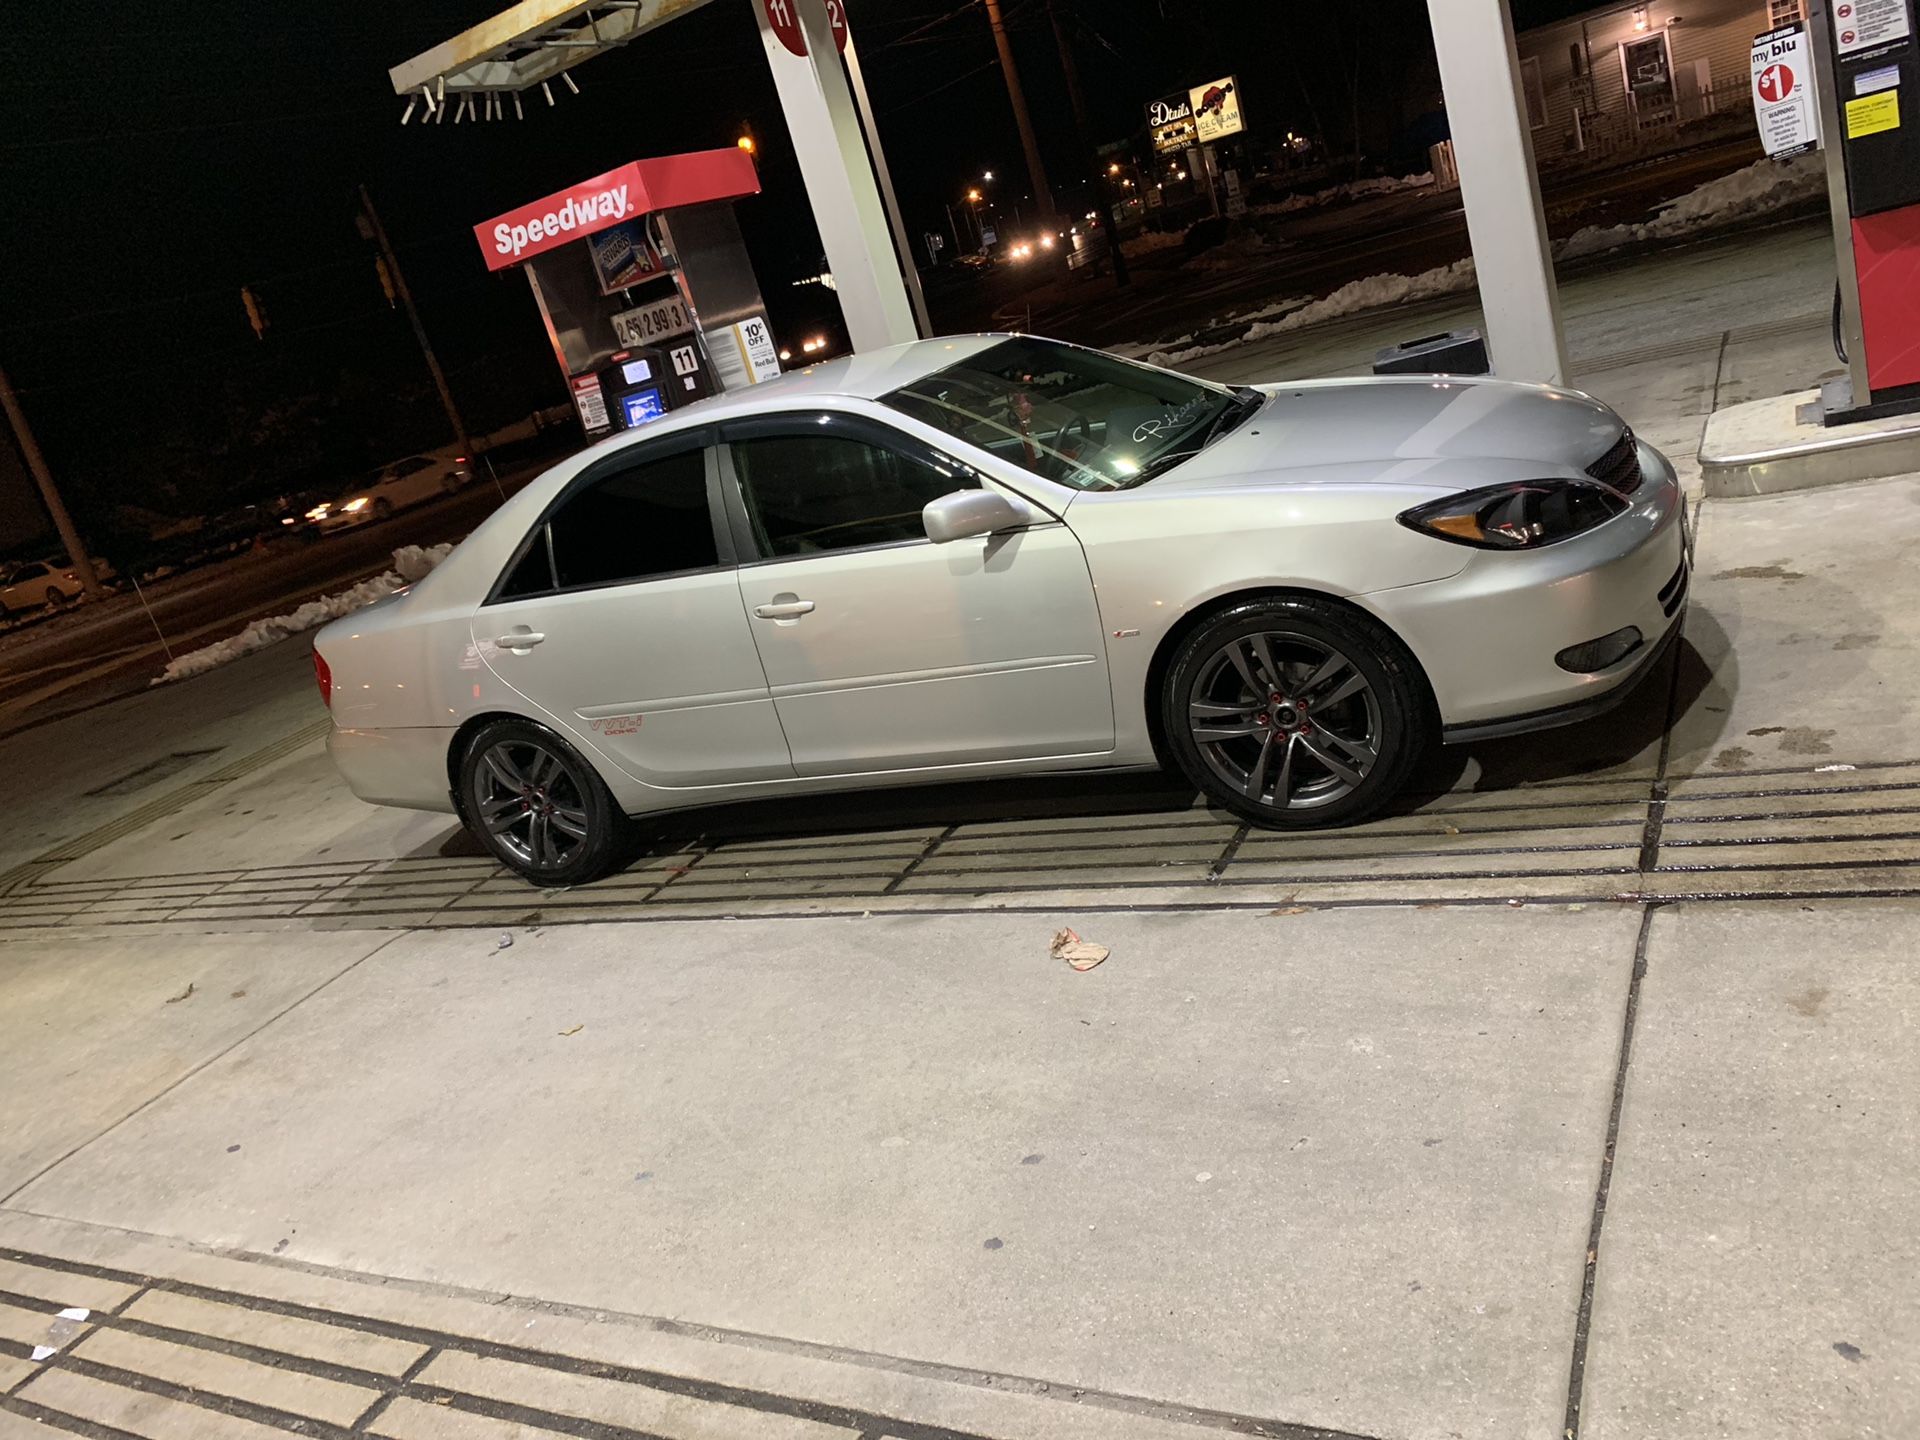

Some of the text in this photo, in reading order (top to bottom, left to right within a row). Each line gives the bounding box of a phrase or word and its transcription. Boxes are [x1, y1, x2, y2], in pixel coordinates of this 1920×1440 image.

[770, 0, 792, 27] 11
[1752, 40, 1797, 63] my blu
[1761, 65, 1784, 99] $1
[1150, 101, 1191, 126] Dtails
[494, 184, 628, 256] Speedway
[748, 335, 765, 346] OFF
[675, 349, 695, 371] 11
[755, 357, 776, 368] Red Bull
